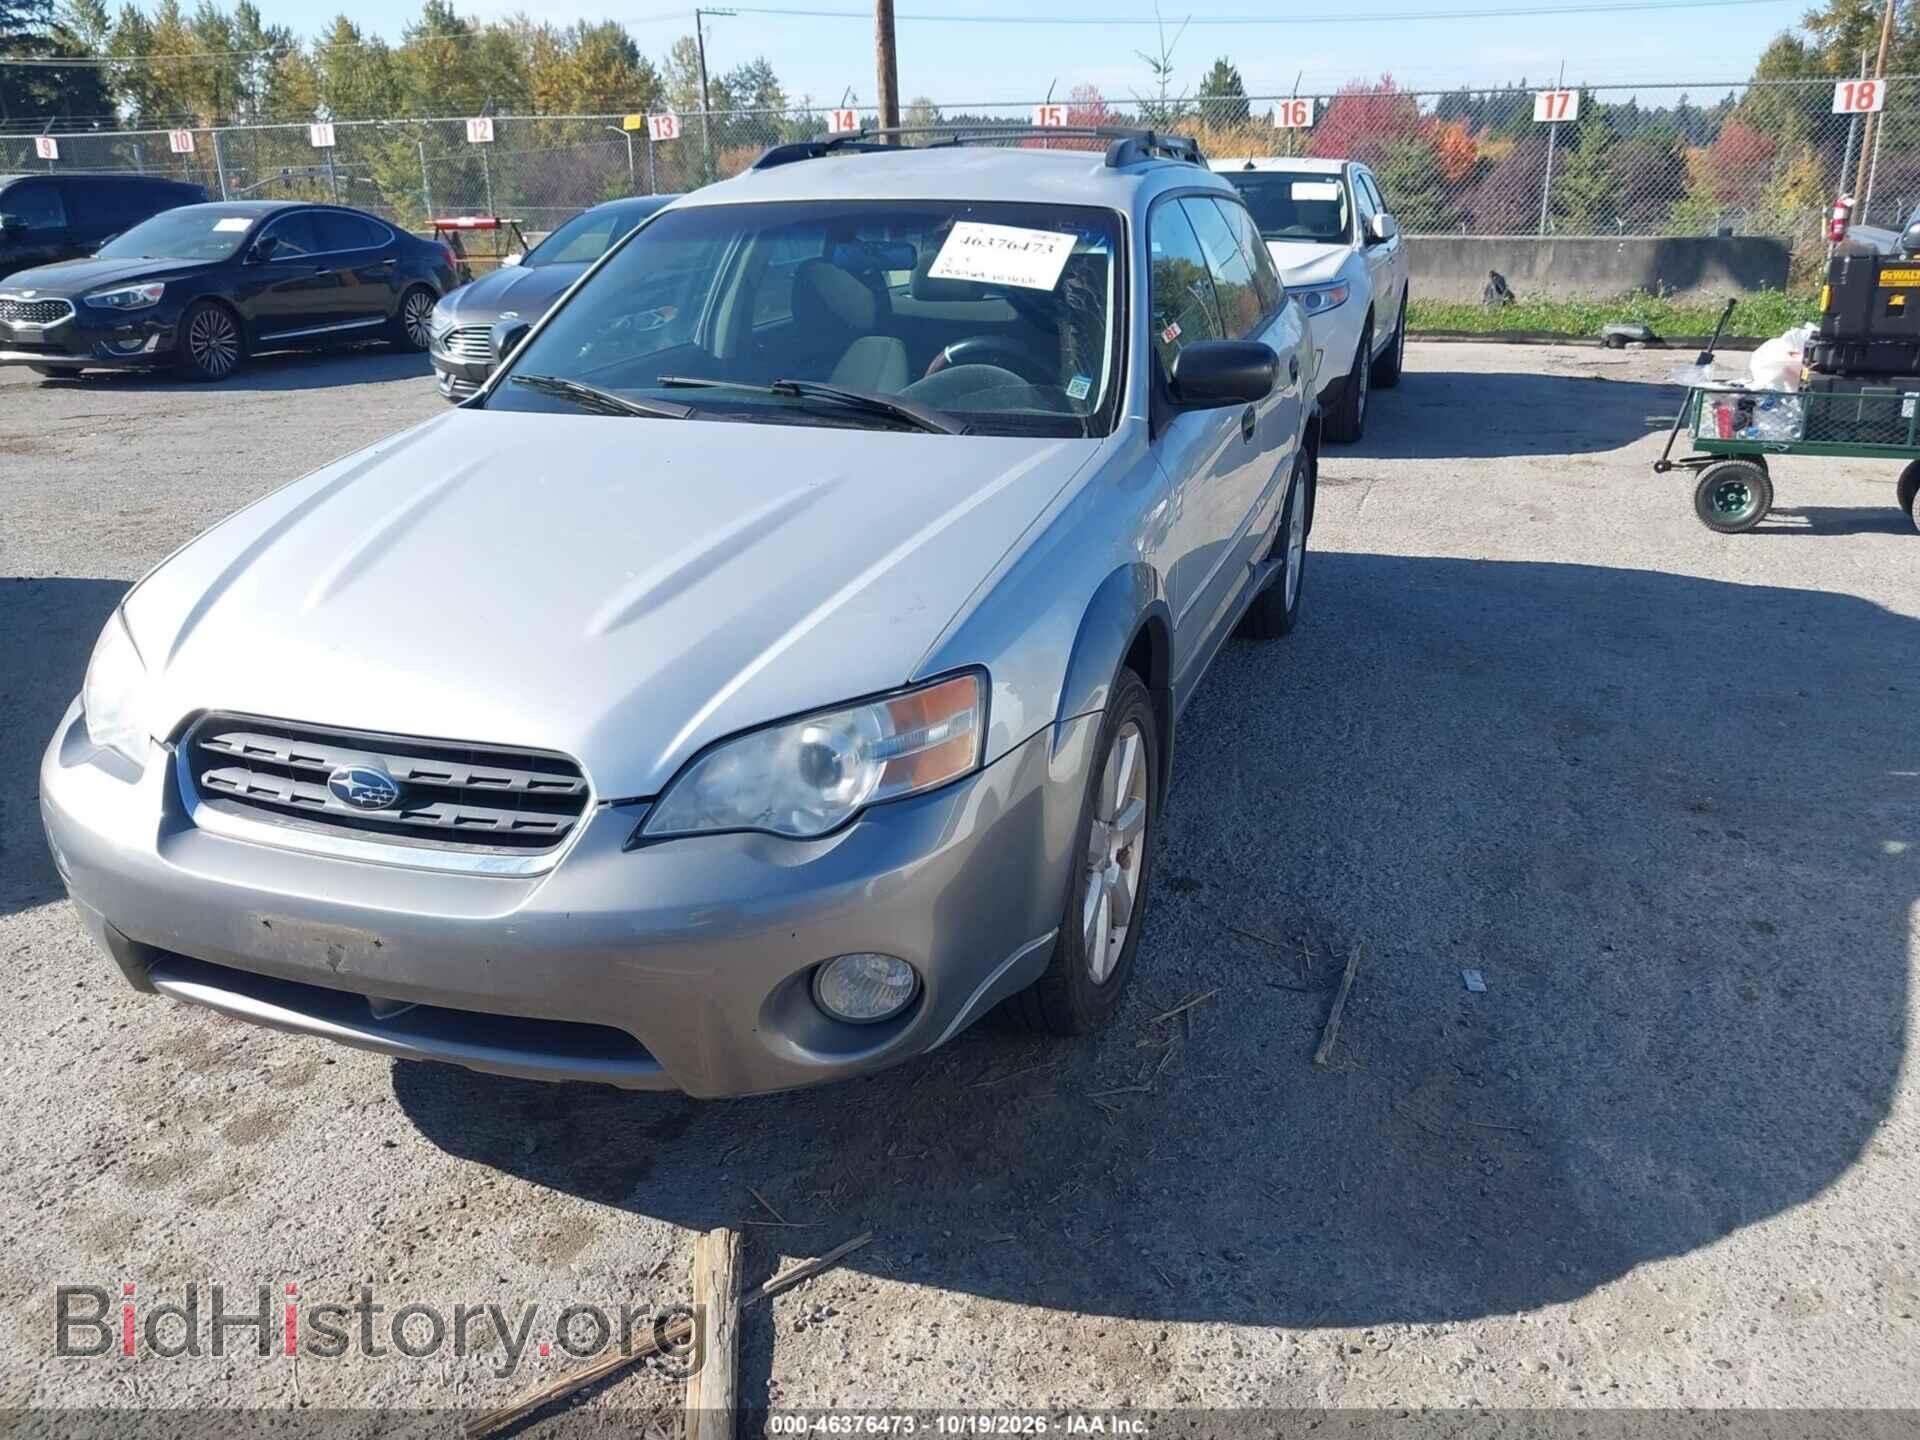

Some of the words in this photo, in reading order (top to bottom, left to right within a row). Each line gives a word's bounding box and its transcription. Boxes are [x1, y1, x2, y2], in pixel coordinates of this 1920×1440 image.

[1545, 93, 1570, 119] 17
[1842, 81, 1876, 112] 18
[834, 110, 855, 130] 14
[1039, 107, 1060, 127] 15
[1282, 101, 1306, 126] 16
[318, 126, 329, 142] 11
[472, 120, 488, 140] 12
[654, 117, 673, 138] 13
[42, 137, 52, 157] 9
[174, 132, 190, 151] 10
